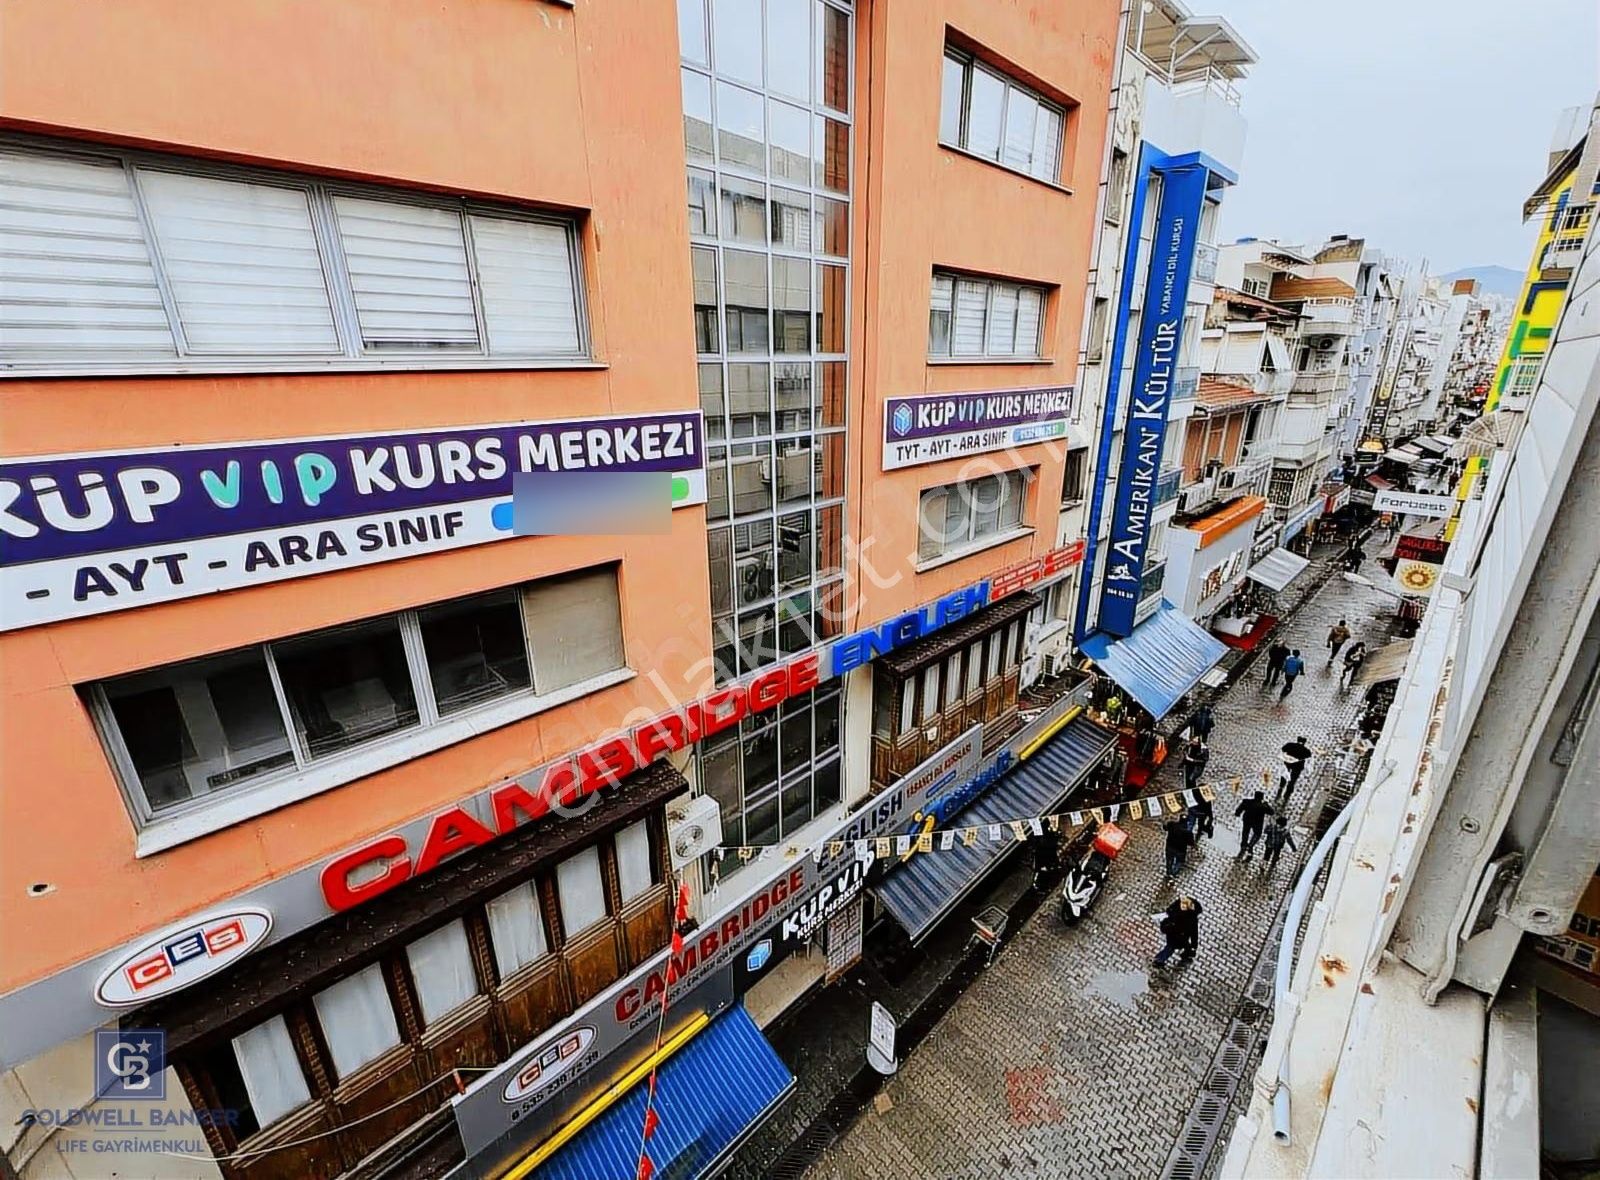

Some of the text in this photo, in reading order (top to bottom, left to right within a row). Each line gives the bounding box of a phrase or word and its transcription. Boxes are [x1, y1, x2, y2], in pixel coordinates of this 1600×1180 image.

[1161, 273, 1176, 318] YABANCI
[1170, 217, 1184, 252] KURSU
[1134, 319, 1178, 420] KÜLTÜR
[896, 444, 920, 461] TYT
[929, 440, 951, 456] AYT
[959, 436, 980, 450] ARA
[982, 430, 1007, 447] SINIF
[916, 403, 955, 429] KÜP
[986, 395, 1021, 420] KURS
[350, 438, 506, 497] KURS
[73, 552, 188, 601] AYT
[244, 529, 347, 573] ARA
[359, 511, 464, 553] SINIF
[320, 652, 822, 912] CAMBRIDGE
[833, 579, 991, 677] ENGLISH
[615, 866, 804, 1023] CAMBRIDGE
[782, 885, 833, 941] KÜP
[797, 910, 824, 940] KURS
[127, 921, 245, 991] CES
